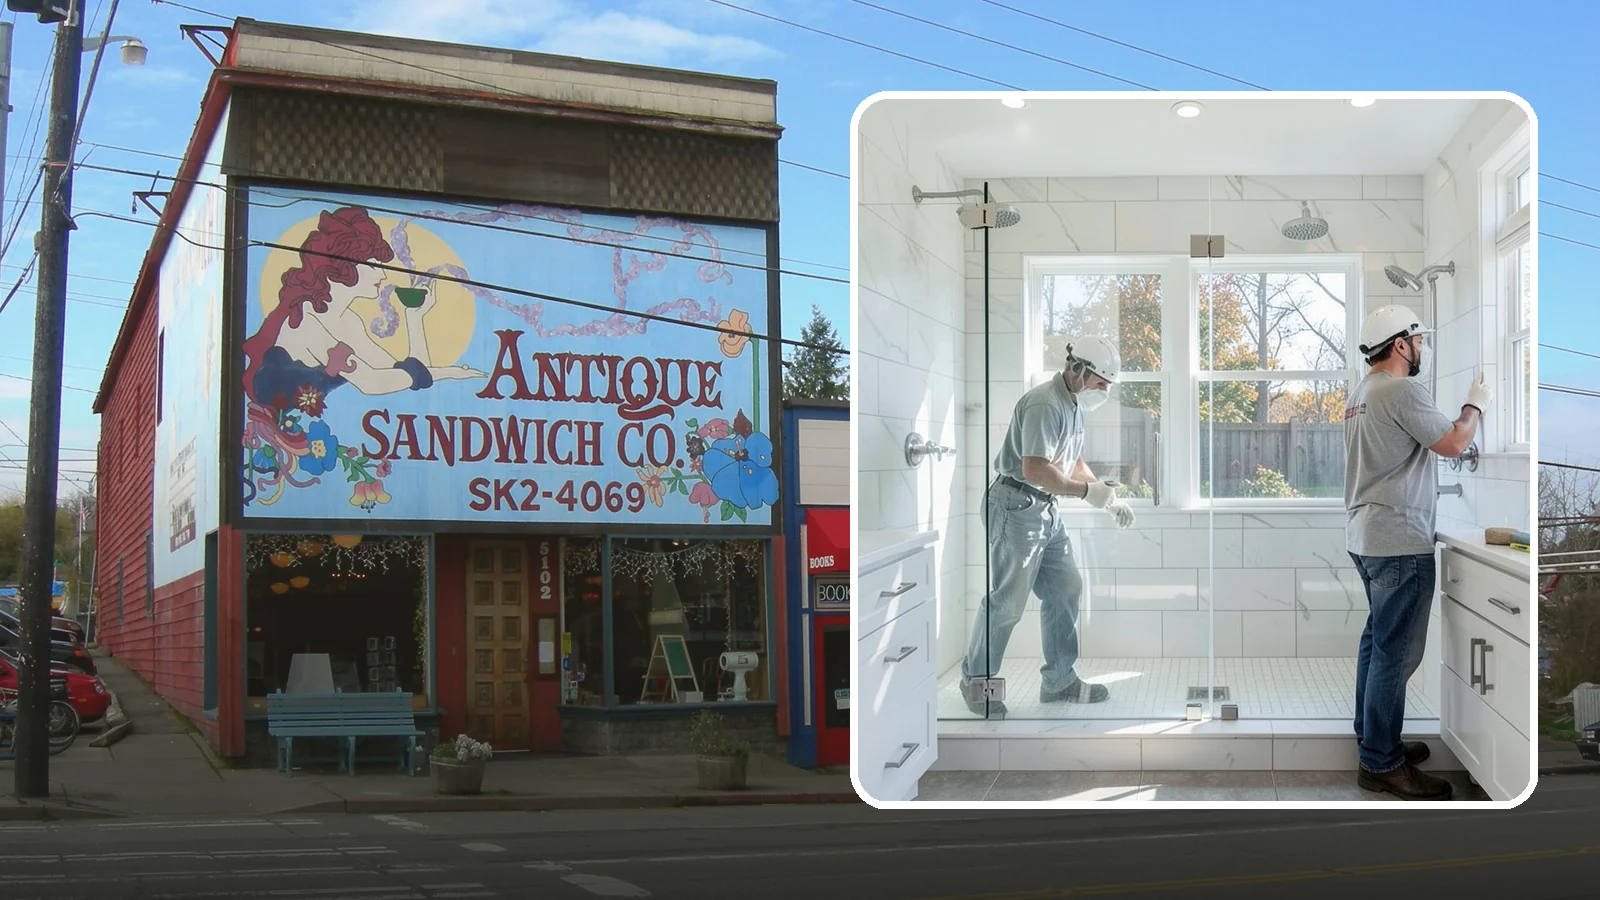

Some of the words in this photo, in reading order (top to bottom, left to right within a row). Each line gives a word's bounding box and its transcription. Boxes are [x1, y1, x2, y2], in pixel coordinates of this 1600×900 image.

[475, 328, 724, 421] ANTIQUE
[361, 408, 605, 468] SANDWICH
[616, 422, 685, 469] CO.
[468, 476, 646, 514] SK2-4069
[540, 542, 551, 599] 5102
[809, 555, 834, 569] BOOKS
